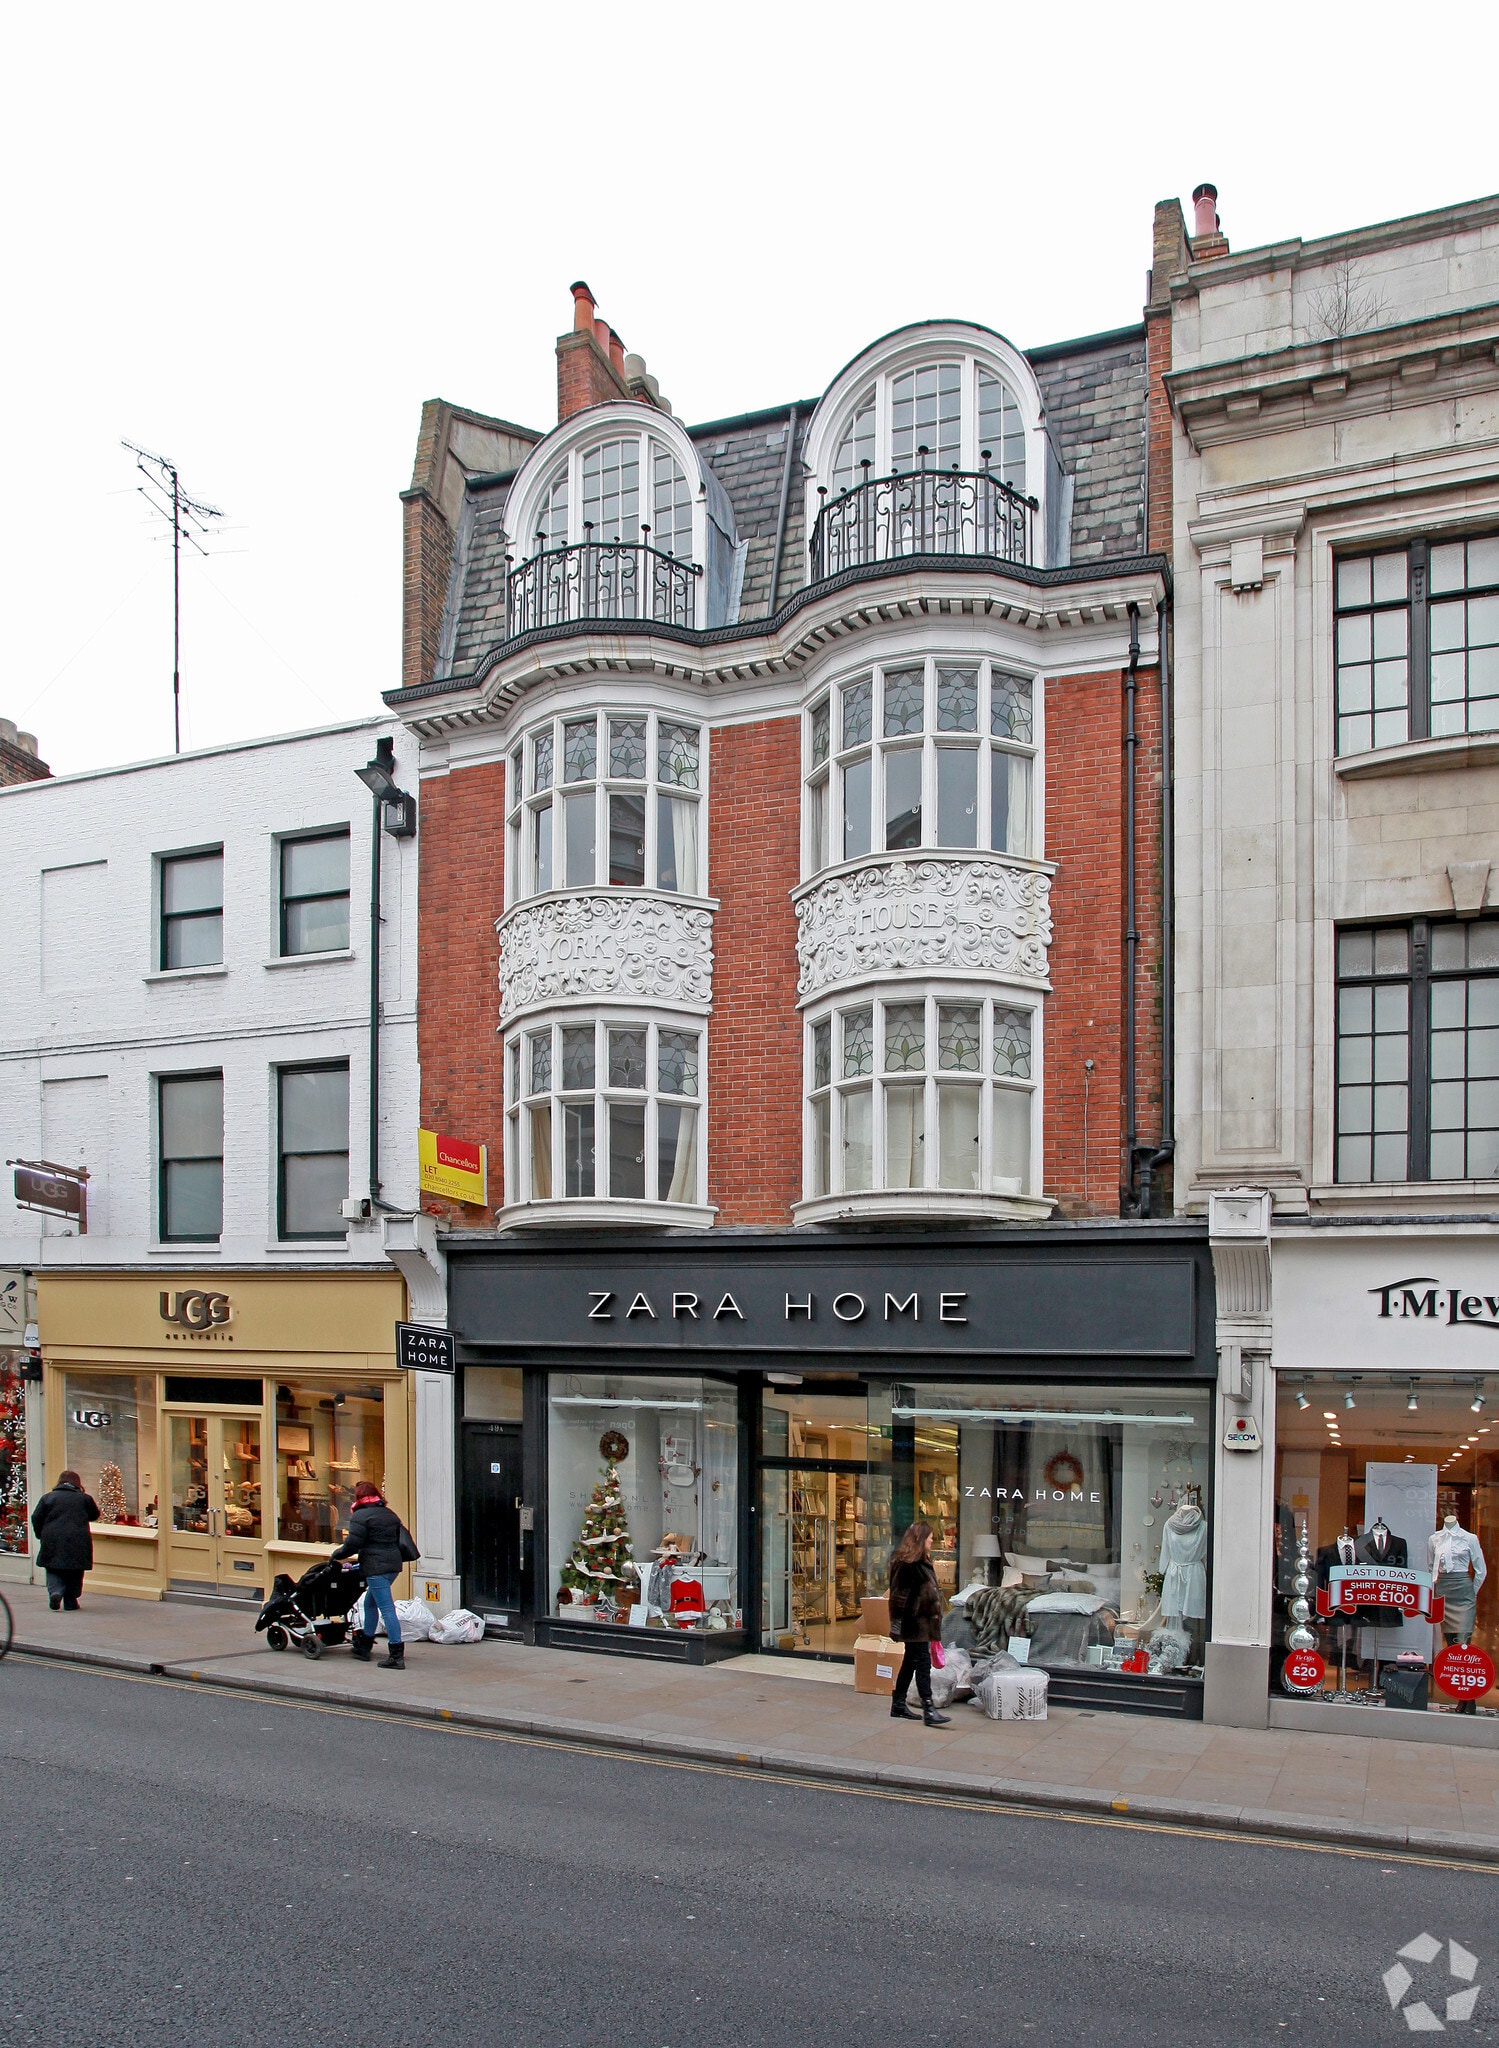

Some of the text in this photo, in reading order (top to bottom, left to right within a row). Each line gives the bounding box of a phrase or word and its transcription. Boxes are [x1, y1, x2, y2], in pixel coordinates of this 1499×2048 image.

[858, 902, 944, 935] HOUSE
[540, 935, 612, 963] YORK
[440, 1151, 478, 1170] Chancellors
[424, 1164, 437, 1174] LET
[32, 1177, 68, 1198] UGG
[159, 1289, 231, 1330] UGG
[587, 1292, 968, 1322] ZARA HOME
[165, 1332, 233, 1341] australia
[408, 1335, 447, 1350] ZARA
[408, 1351, 447, 1366] HOME
[74, 1410, 111, 1428] UGG
[1227, 1433, 1256, 1442] SECOM
[965, 1486, 1101, 1503] ZARA HOME
[287, 1522, 304, 1532] UGG
[1346, 1568, 1416, 1580] LAST 10 DAYS
[1350, 1582, 1409, 1592] SHIRT OFFER
[1344, 1589, 1415, 1605] 5 FOR £100
[1447, 1652, 1482, 1664] Suit Offer
[1292, 1666, 1317, 1677] £20
[1443, 1665, 1487, 1675] MEN'S SUITS
[1451, 1674, 1487, 1687] £199
